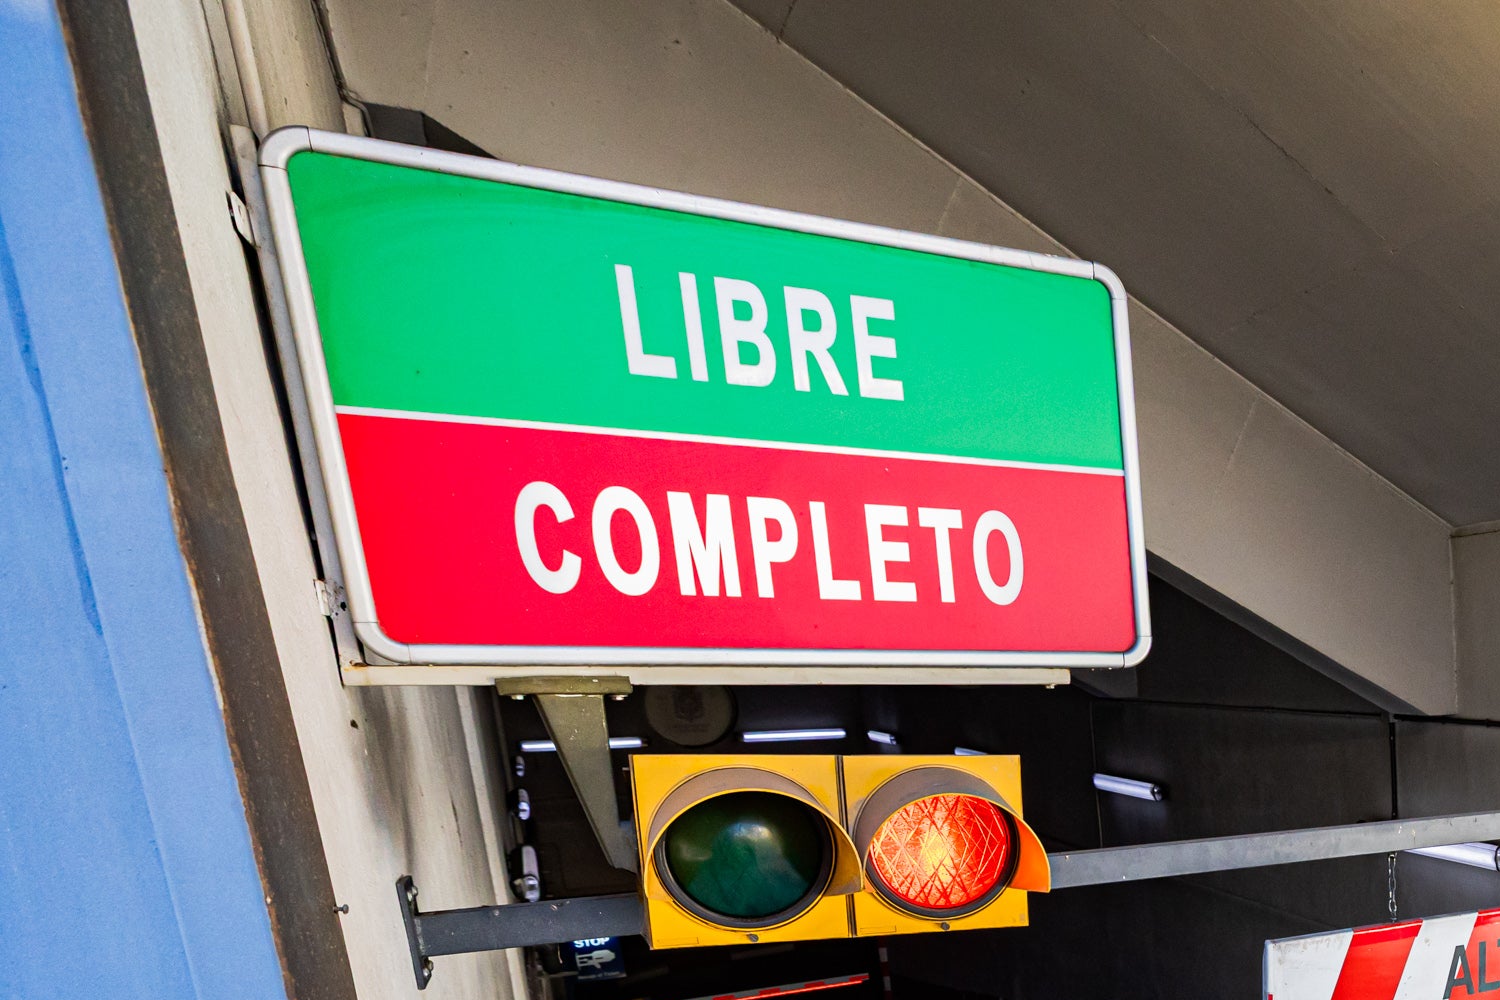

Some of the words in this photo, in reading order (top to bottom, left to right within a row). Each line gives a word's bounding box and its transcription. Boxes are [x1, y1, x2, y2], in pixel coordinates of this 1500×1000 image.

[614, 264, 905, 401] LIBRE
[514, 481, 1024, 606] COMPLETO
[573, 937, 610, 949] STOP
